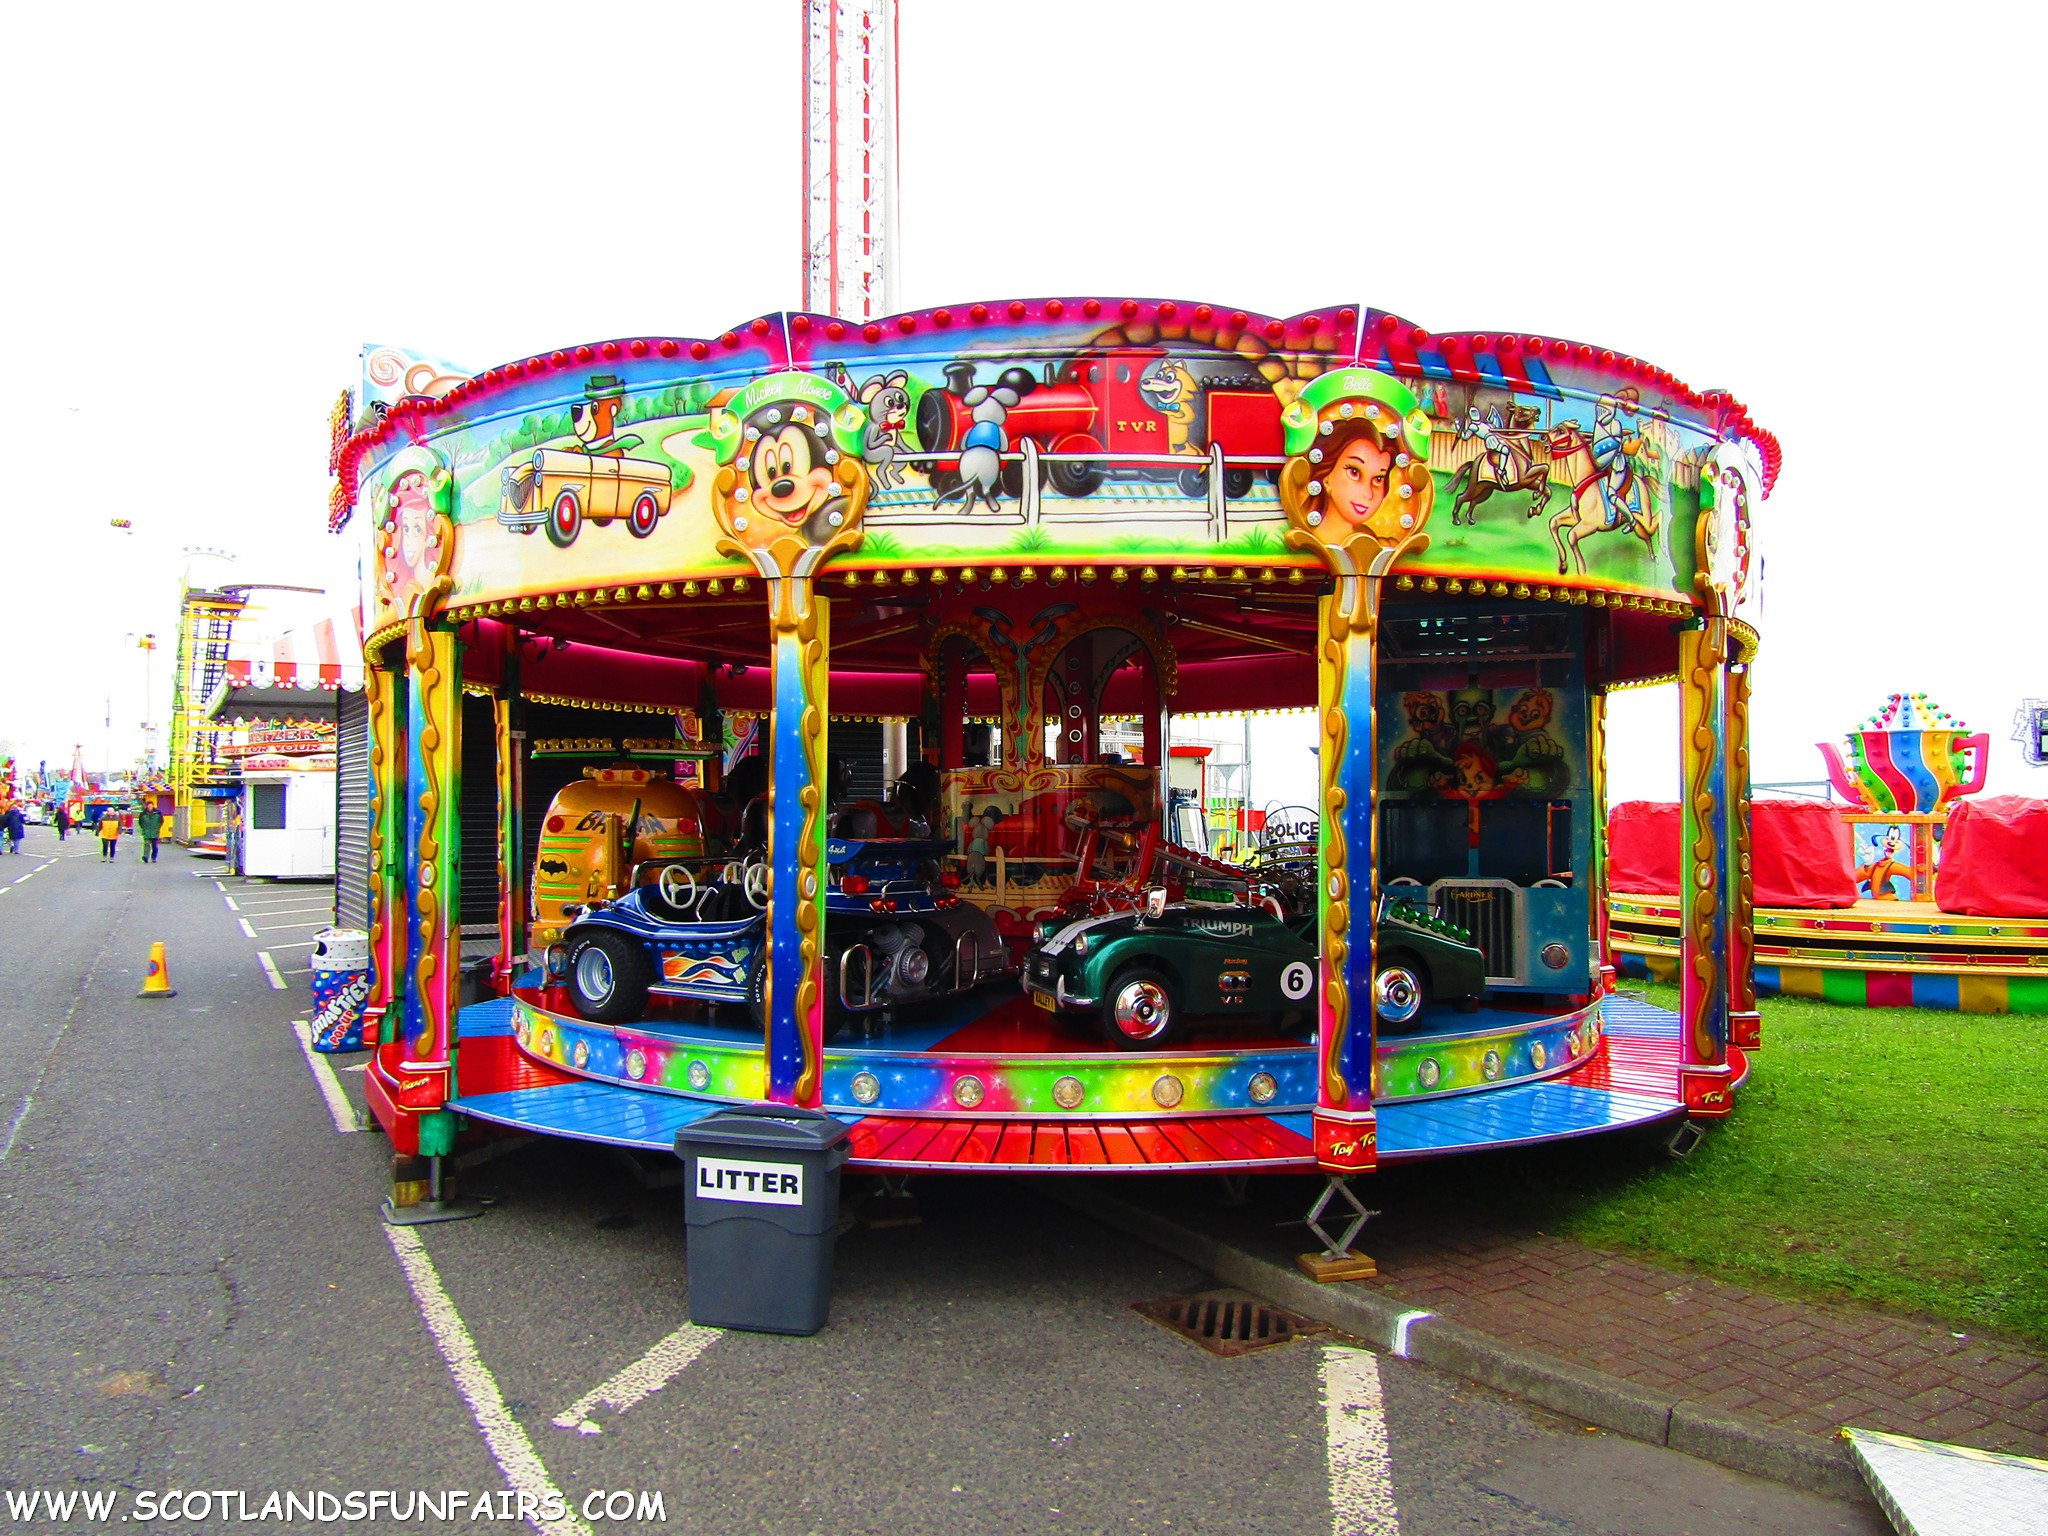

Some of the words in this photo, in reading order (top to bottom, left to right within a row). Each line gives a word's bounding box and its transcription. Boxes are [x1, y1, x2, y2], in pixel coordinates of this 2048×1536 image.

[1342, 375, 1373, 391] Belle
[745, 381, 783, 409] Mickey
[795, 377, 832, 400] Mouse
[1116, 420, 1157, 432] TVR
[1266, 822, 1318, 840] POLICE
[1183, 917, 1253, 938] TRIUMPH
[1288, 968, 1304, 991] 6
[1330, 1141, 1356, 1156] Toy
[701, 1168, 798, 1194] LITTER
